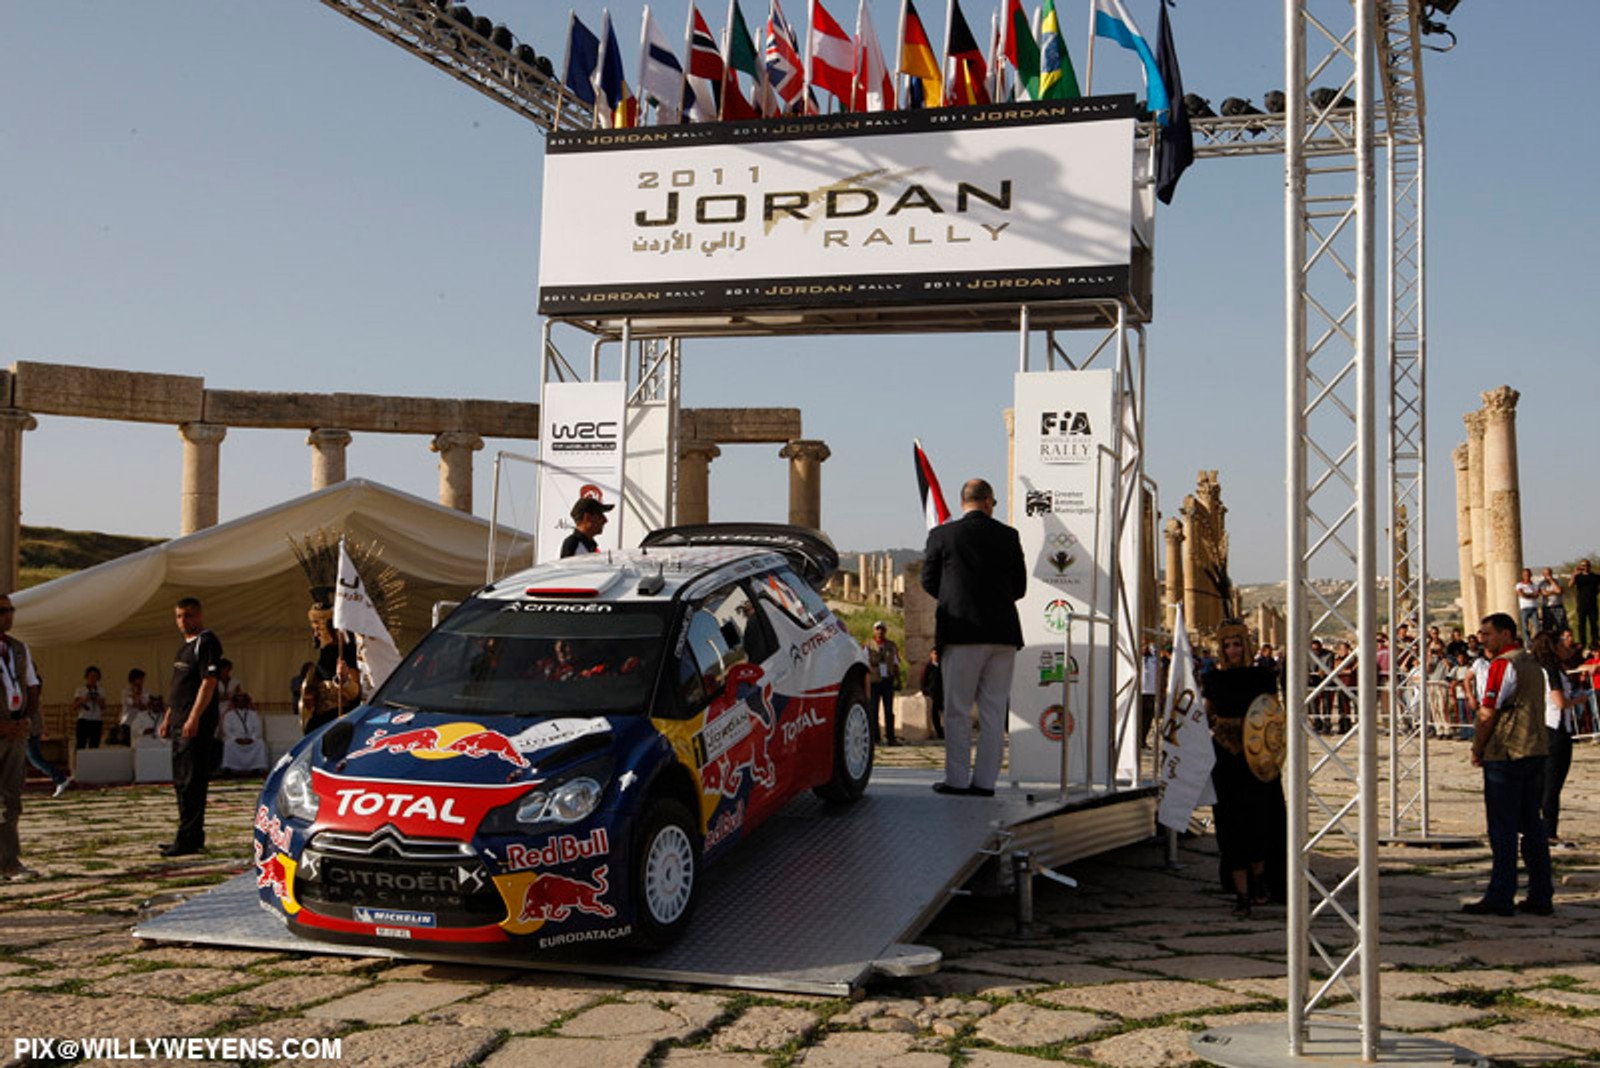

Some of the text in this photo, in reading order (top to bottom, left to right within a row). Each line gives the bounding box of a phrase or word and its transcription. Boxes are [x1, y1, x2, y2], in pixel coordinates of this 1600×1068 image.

[972, 107, 1066, 122] JORDAN
[1072, 103, 1119, 113] RALLY
[772, 120, 861, 135] JORDAN
[865, 118, 908, 127] RALLY
[586, 132, 668, 146] JORDAN
[638, 166, 760, 189] 2011
[634, 179, 1013, 228] JORDAN
[632, 229, 746, 258] رالي الأردن
[823, 221, 1010, 249] RALLY
[764, 284, 853, 296] JORDAN
[858, 283, 902, 291] RALLY
[966, 277, 1062, 290] JORDAN
[1067, 275, 1115, 284] RALLY
[579, 291, 661, 303] JORDAN
[551, 421, 617, 440] WRC
[781, 708, 827, 745] TOTAL
[335, 788, 466, 825] TOTAL
[507, 827, 609, 871] Red Bull
[373, 911, 433, 925] MICHELIN
[539, 924, 632, 949] EURODATACAR
